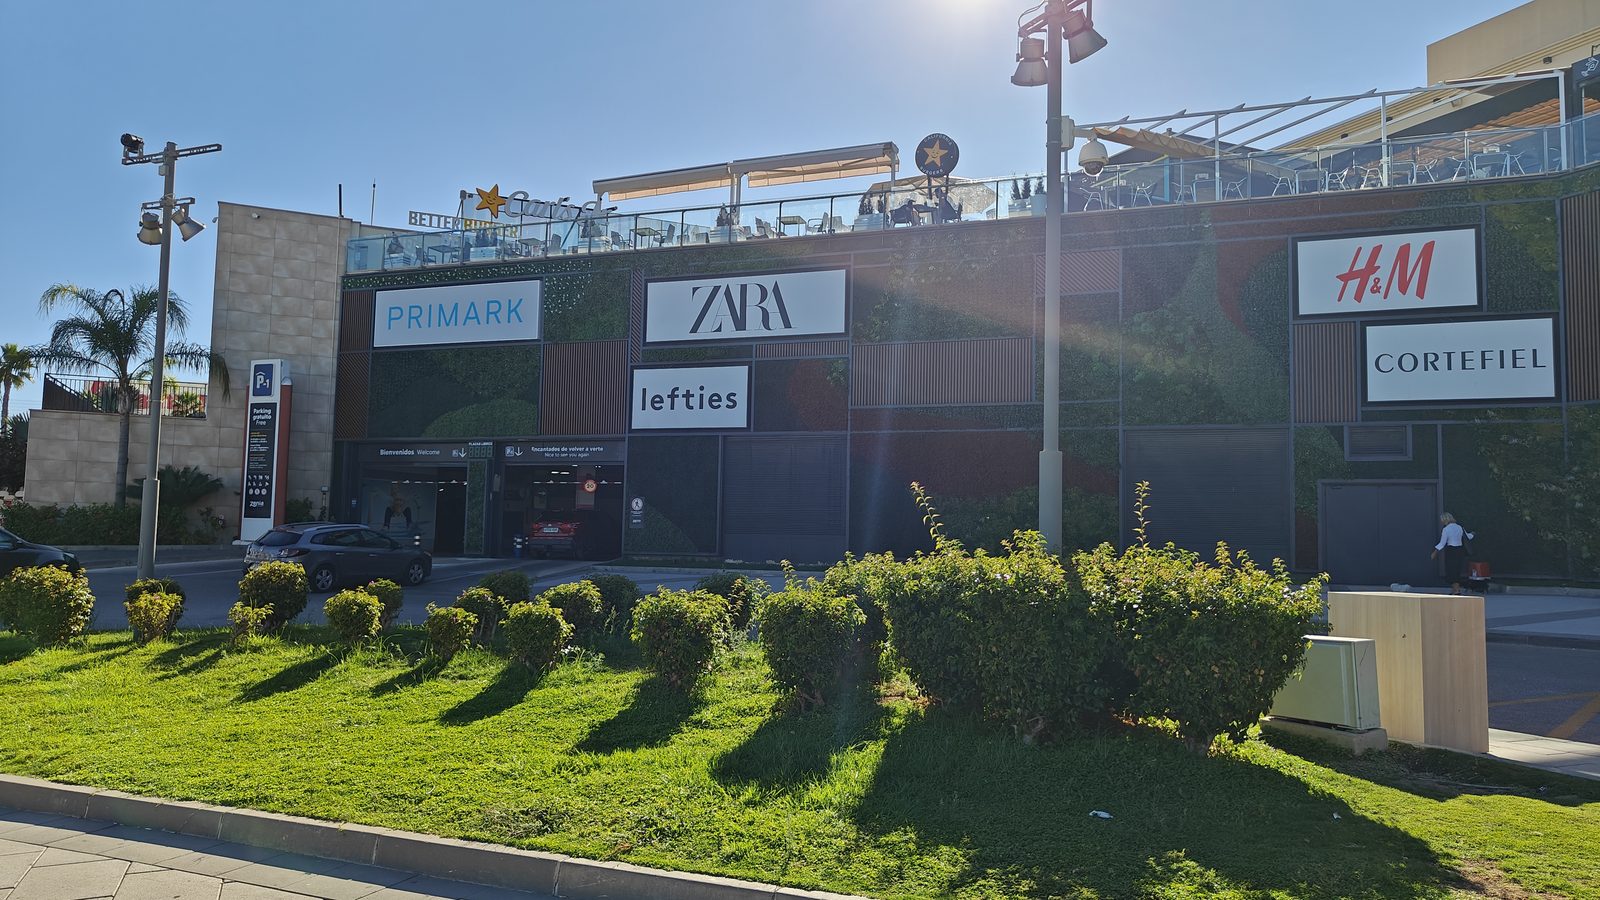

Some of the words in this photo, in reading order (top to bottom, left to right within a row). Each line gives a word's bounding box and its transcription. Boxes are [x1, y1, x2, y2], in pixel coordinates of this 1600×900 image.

[408, 210, 460, 230] BETTER
[1337, 240, 1436, 304] H&M
[387, 297, 524, 330] PRIMARK
[689, 281, 793, 333] ZARA
[1375, 348, 1547, 373] CORTEFIEL
[642, 384, 737, 412] lefties
